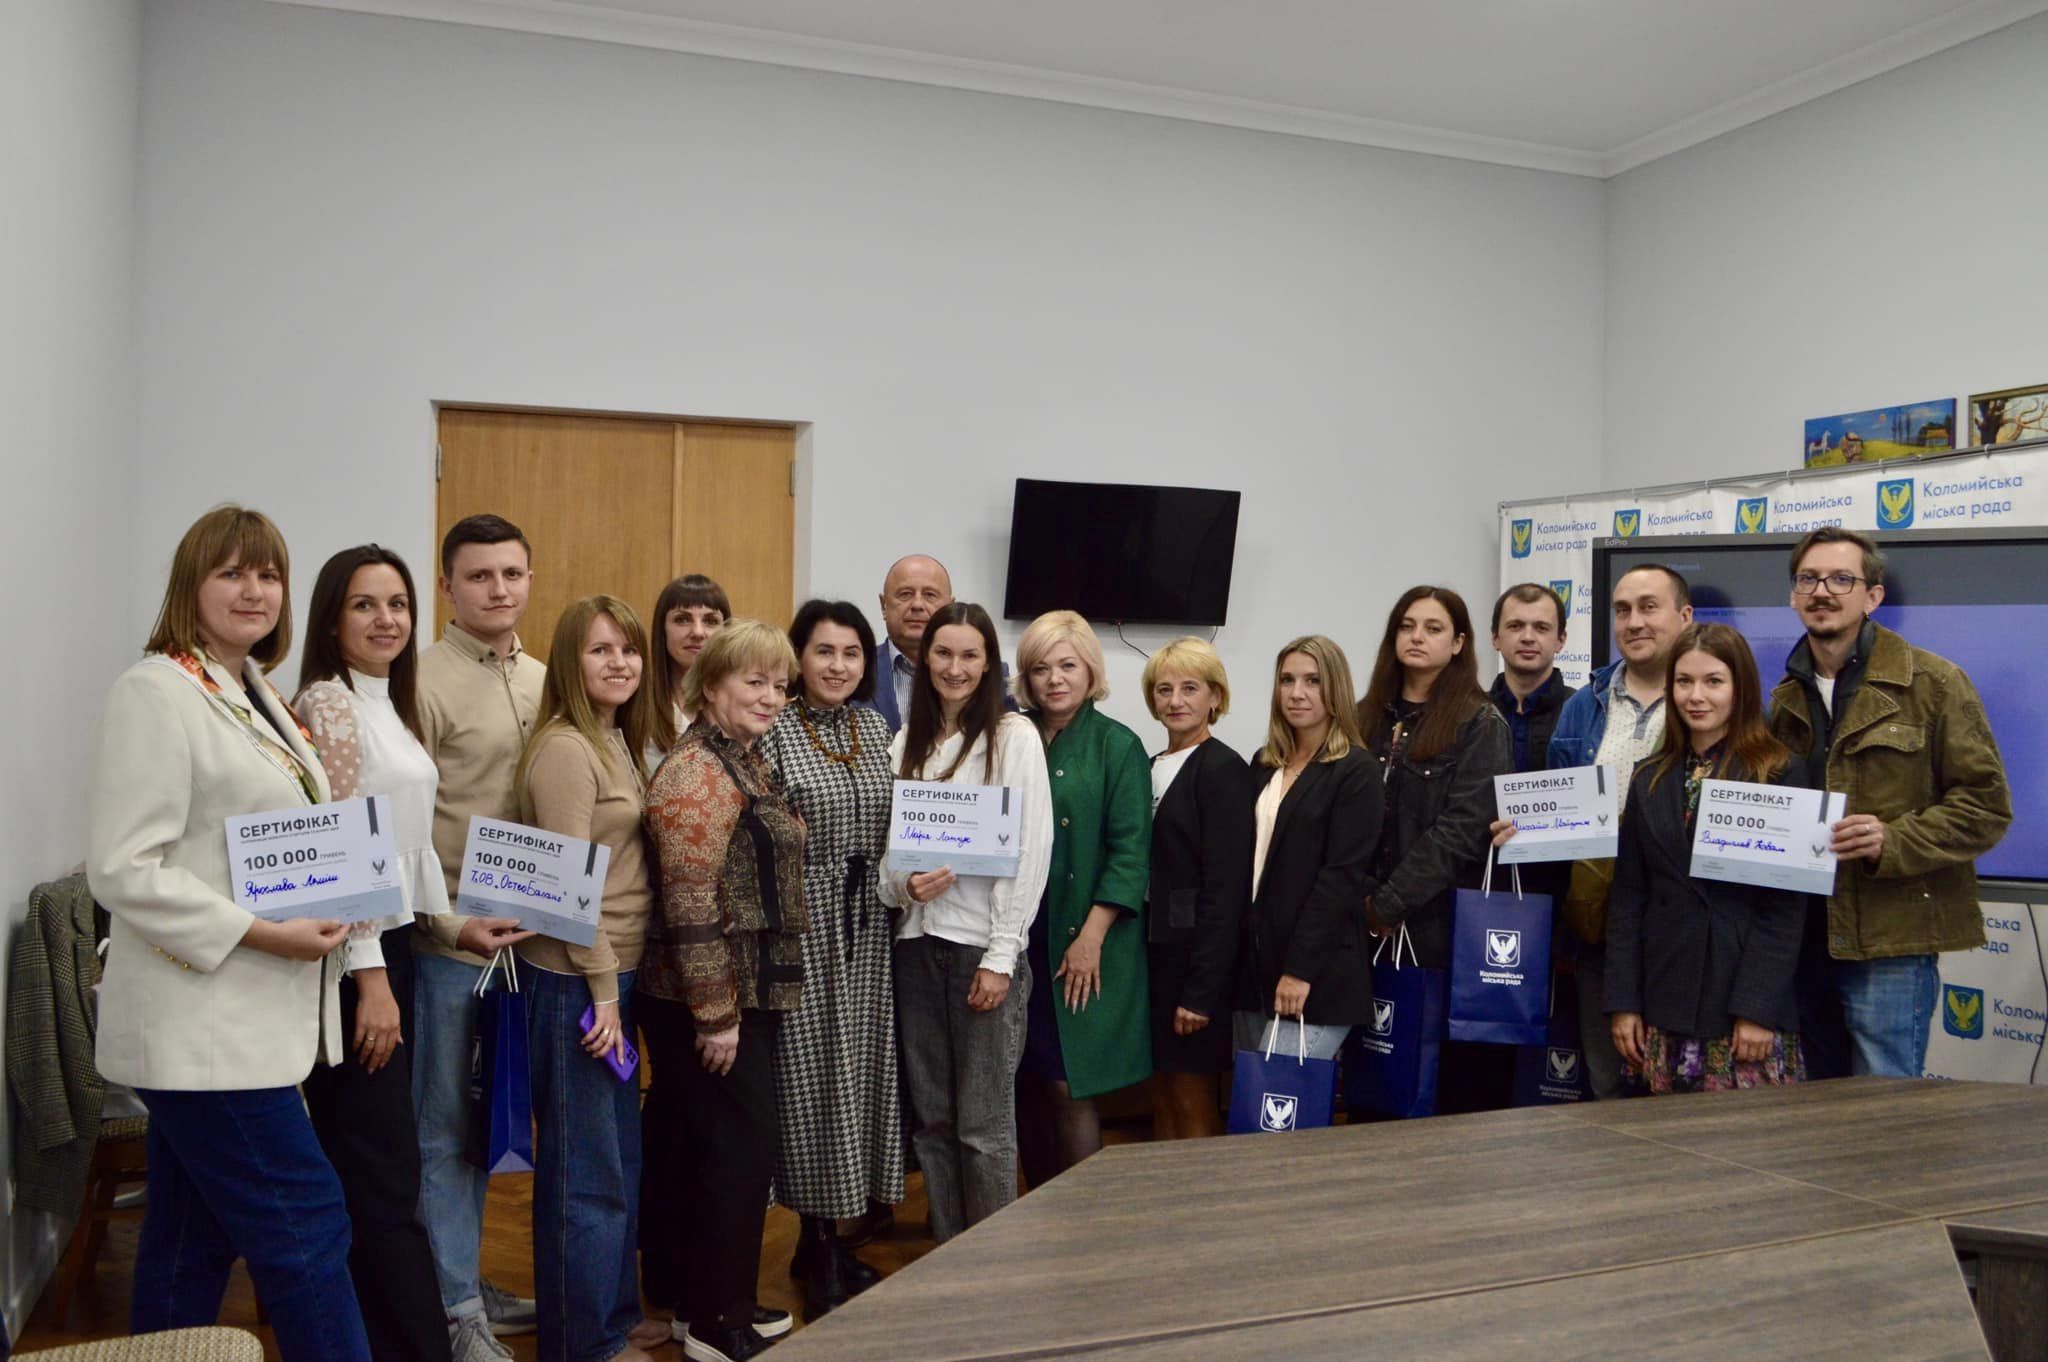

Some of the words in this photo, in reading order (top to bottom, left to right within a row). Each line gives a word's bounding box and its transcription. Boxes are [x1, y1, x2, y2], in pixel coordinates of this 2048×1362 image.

[1922, 475, 2023, 498] Коломийська
[1774, 495, 1852, 513] Коломийська
[1922, 504, 1966, 520] міська
[1970, 500, 2012, 519] рада
[1536, 519, 1597, 534] Коломийська
[1647, 509, 1713, 527] Коломийська
[1535, 540, 1564, 551] міська
[1566, 539, 1588, 552] рада
[1504, 777, 1575, 792] СЕРТИФІКАТ
[902, 789, 979, 802] СЕРТИФІКАТ
[1711, 789, 1793, 806] СЕРТИФІКАТ
[1506, 804, 1529, 815] 100
[1532, 801, 1557, 813] 000
[240, 813, 340, 839] СЕРТИФІКАТ
[901, 811, 925, 821] 100
[929, 812, 956, 824] 000
[1708, 813, 1732, 825] 100
[1736, 816, 1766, 829] 000
[479, 826, 564, 854] СЕРТИФІКАТ
[244, 853, 278, 871] 100
[283, 848, 317, 865] 000
[475, 852, 503, 867] 100
[507, 858, 537, 874] 000
[245, 878, 296, 902] Ярослава
[1984, 917, 2021, 932] ська
[1969, 940, 2009, 955] ада
[1993, 1023, 2044, 1046] міська
